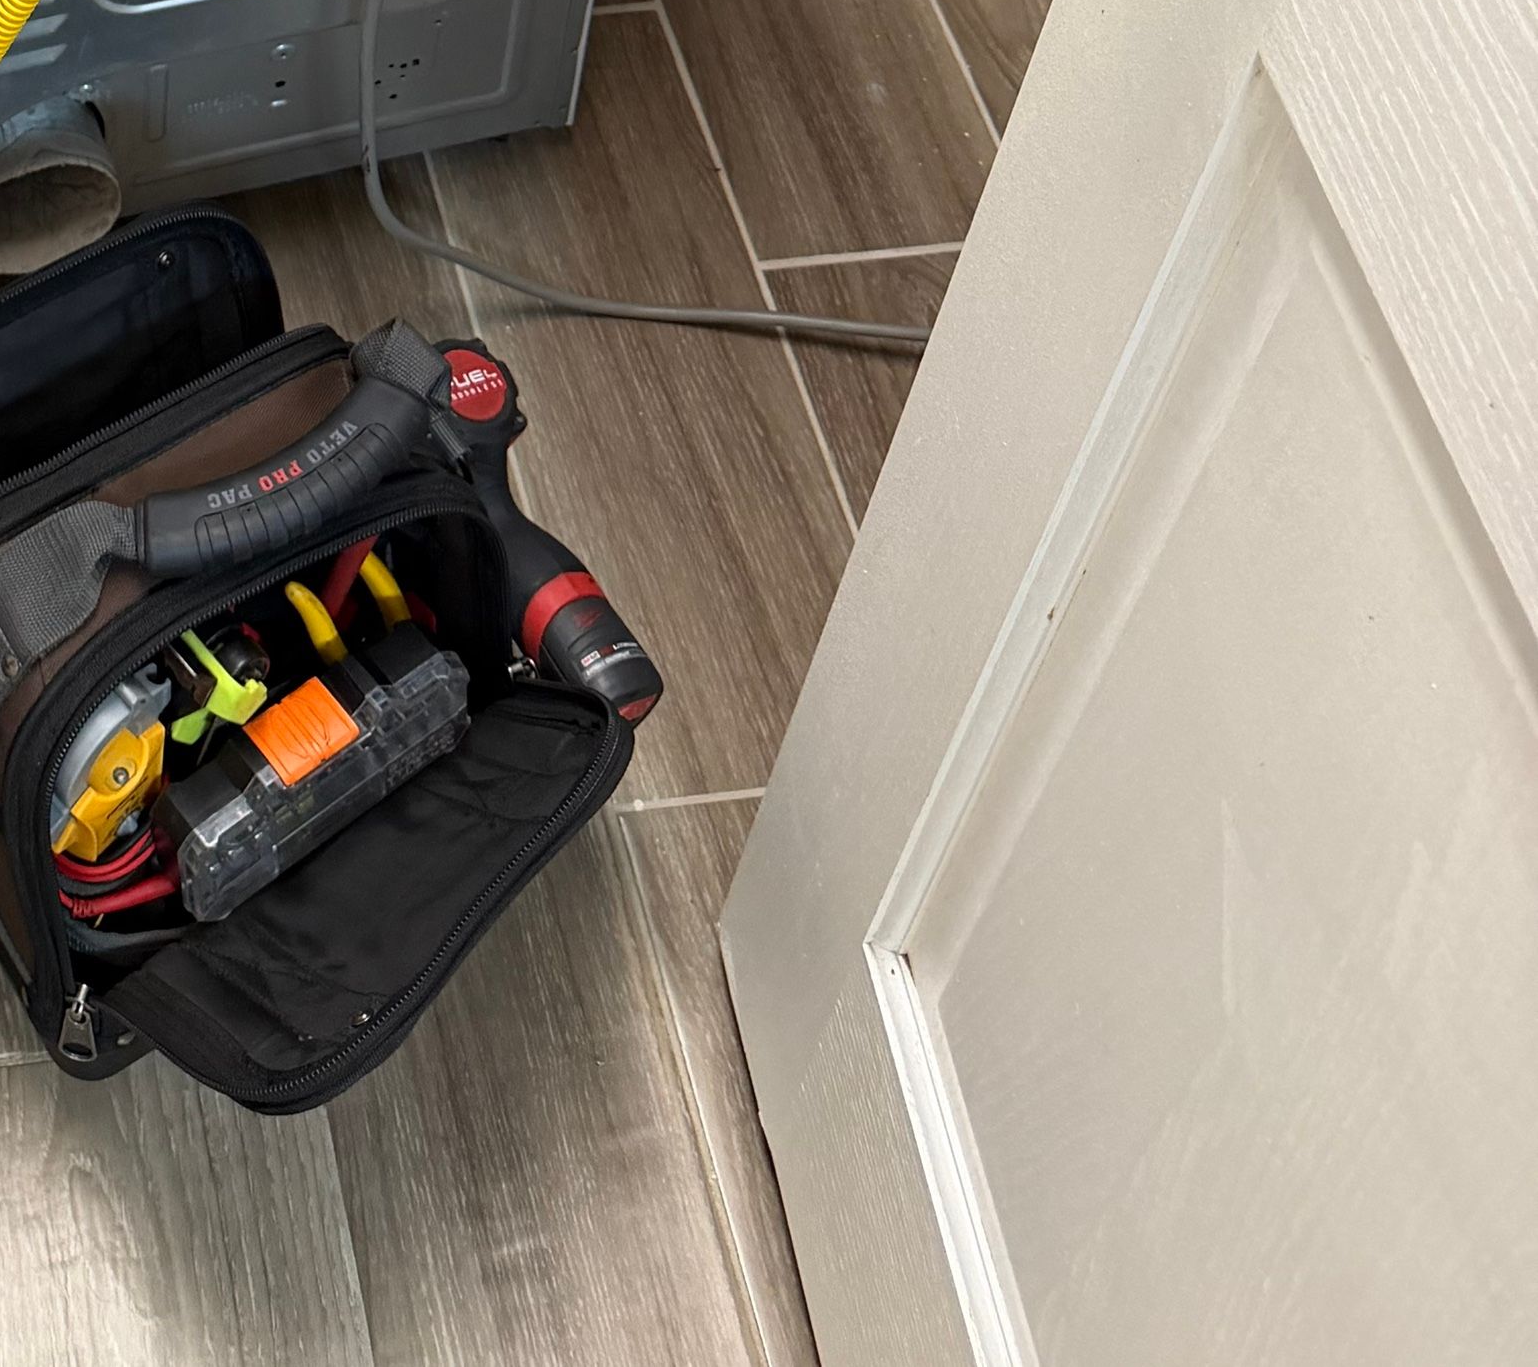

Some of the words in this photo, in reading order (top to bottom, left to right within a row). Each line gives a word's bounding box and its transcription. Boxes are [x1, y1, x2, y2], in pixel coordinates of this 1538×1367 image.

[451, 369, 498, 387] UEL
[306, 420, 358, 464] VETO
[258, 460, 303, 491] PRO
[207, 484, 253, 509] PAC
